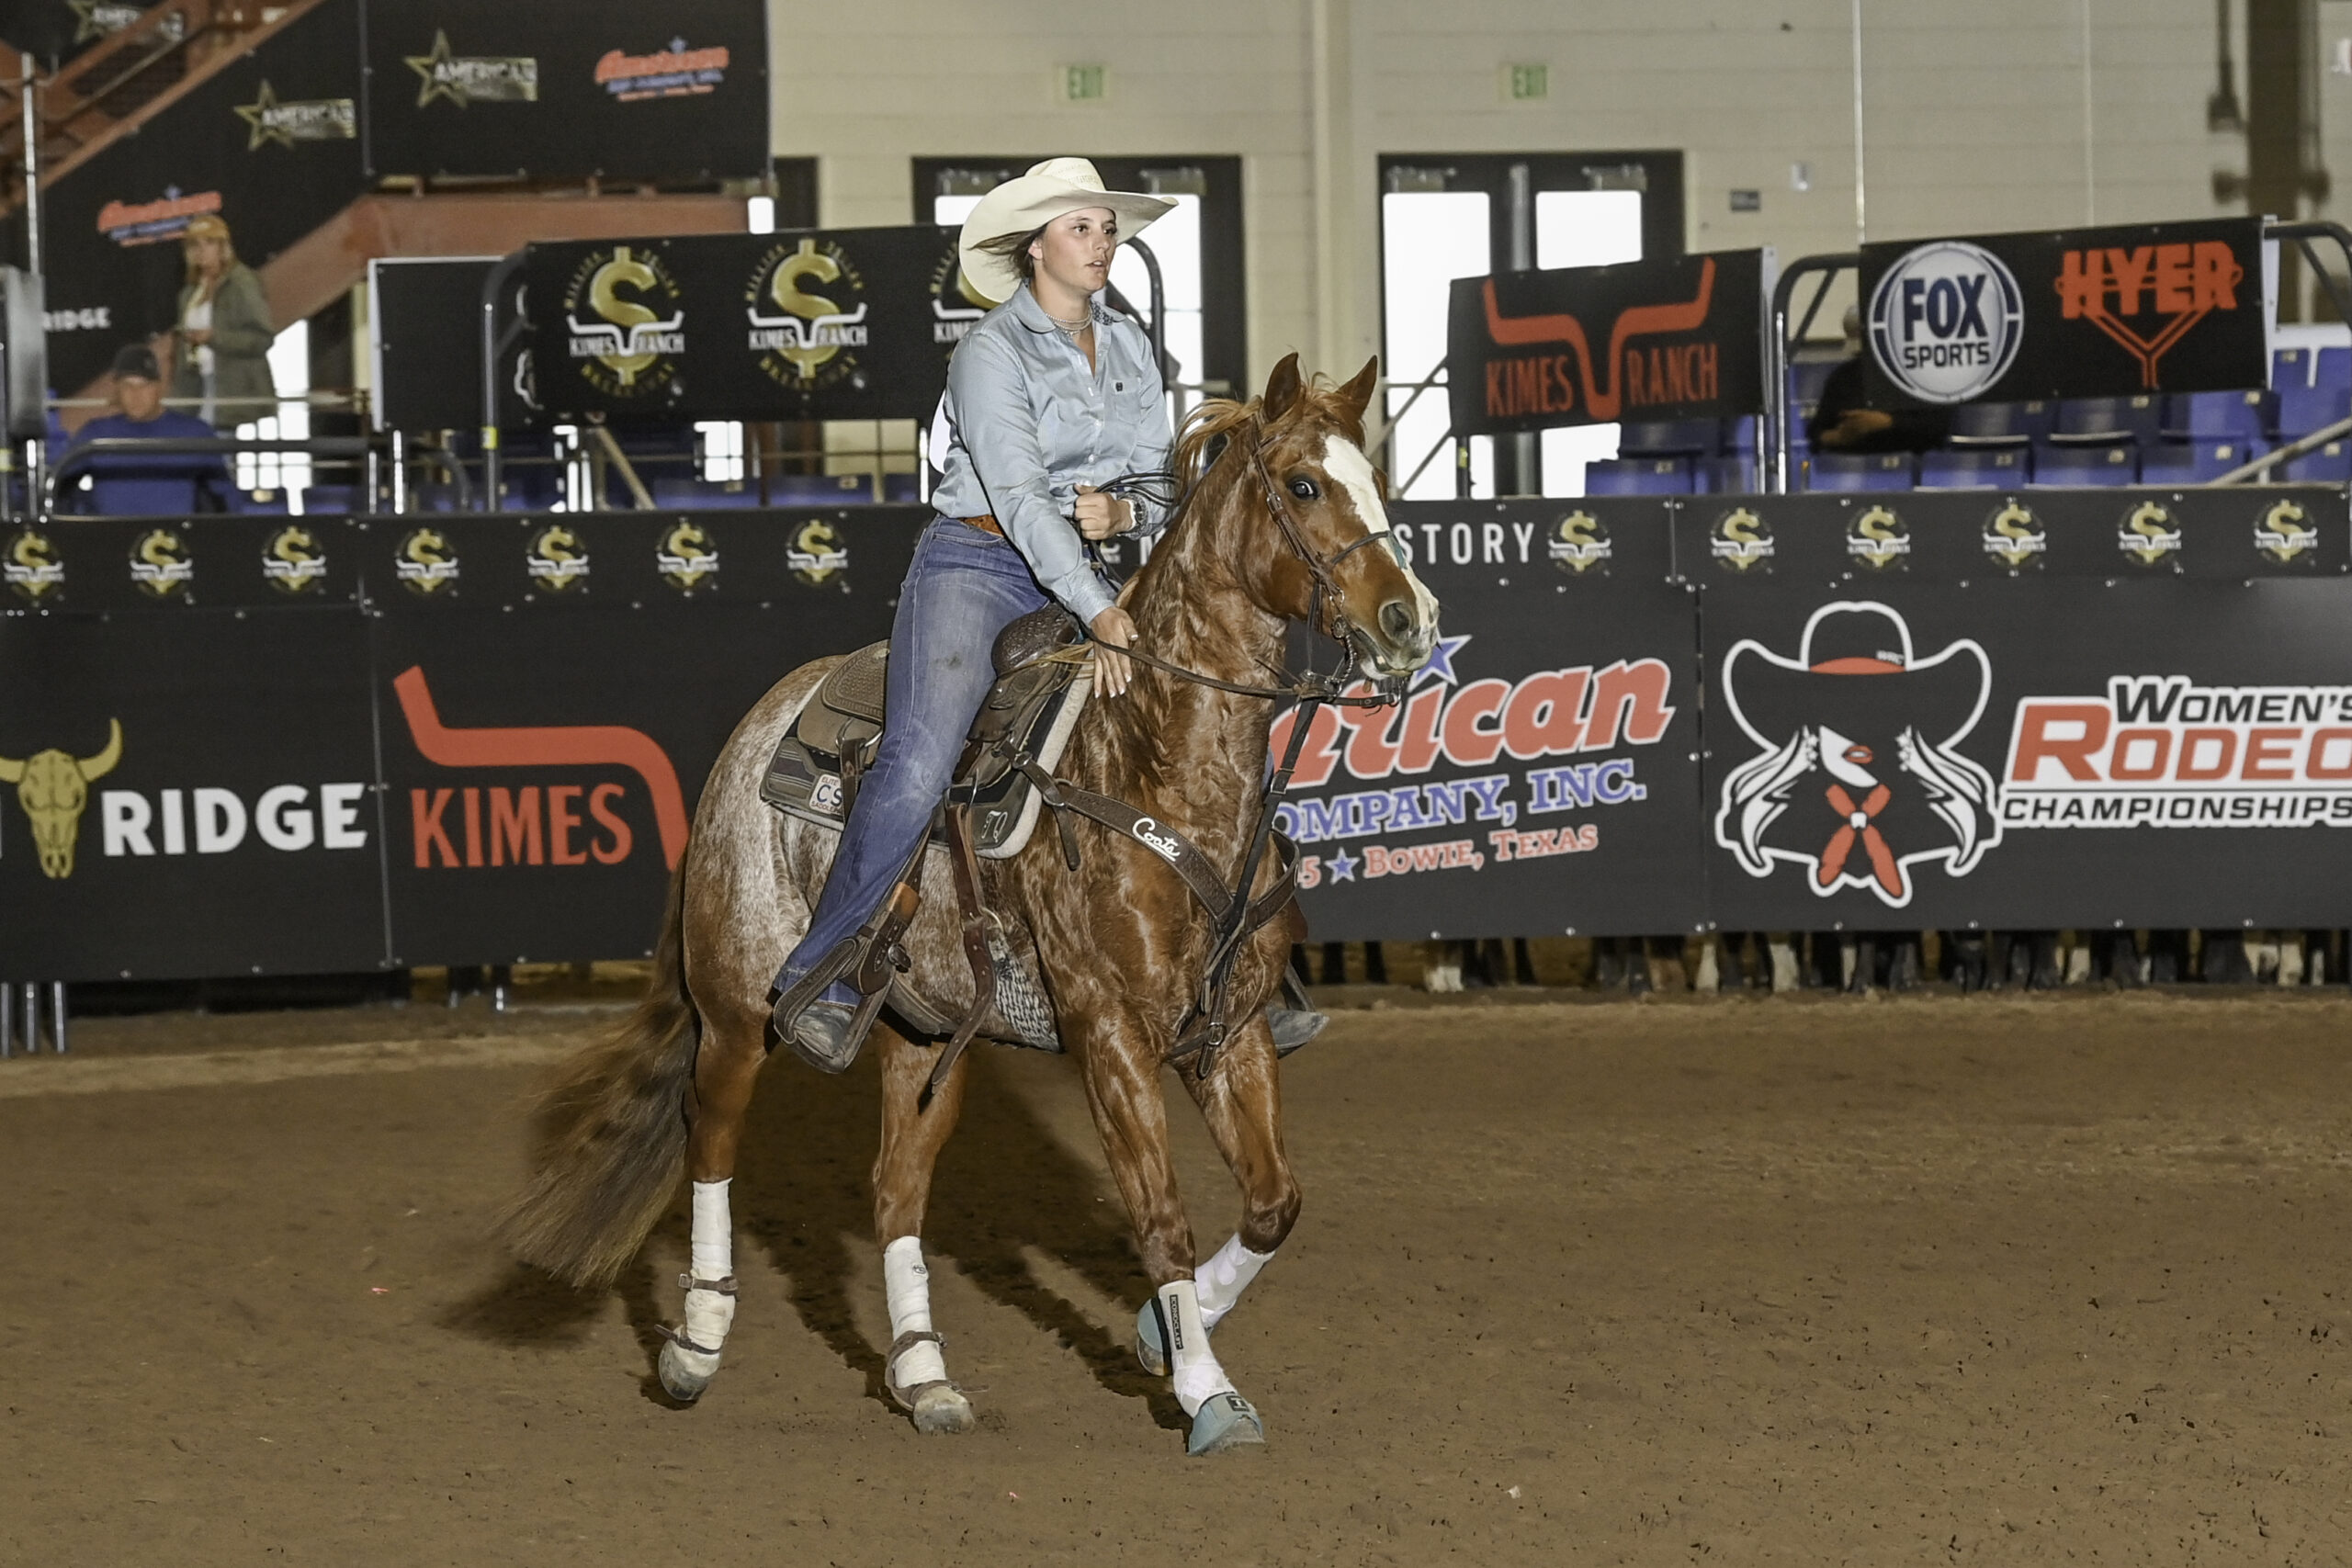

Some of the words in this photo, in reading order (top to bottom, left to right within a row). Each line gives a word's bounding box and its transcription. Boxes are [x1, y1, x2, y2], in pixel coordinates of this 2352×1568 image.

[1903, 275, 1988, 342] FOX
[2061, 241, 2238, 320] HYER
[1486, 355, 1574, 418] KIMES
[1625, 342, 1720, 407] RANCH
[1904, 341, 1990, 370] SPORTS
[1269, 658, 1676, 790] erican
[2011, 705, 2352, 782] RODEO
[101, 783, 368, 857] RIDGE
[410, 783, 634, 868] KIMES
[817, 784, 843, 807] CS
[1272, 774, 1517, 843] OMPANY,
[1526, 757, 1647, 814] INC.
[2003, 796, 2352, 821] CHAMPIONSHIPS
[1132, 817, 1181, 862] Coats
[1363, 839, 1485, 878] BOWIE,
[1488, 823, 1599, 862] TEXAS
[1170, 1295, 1183, 1347] ICONOCLAST
